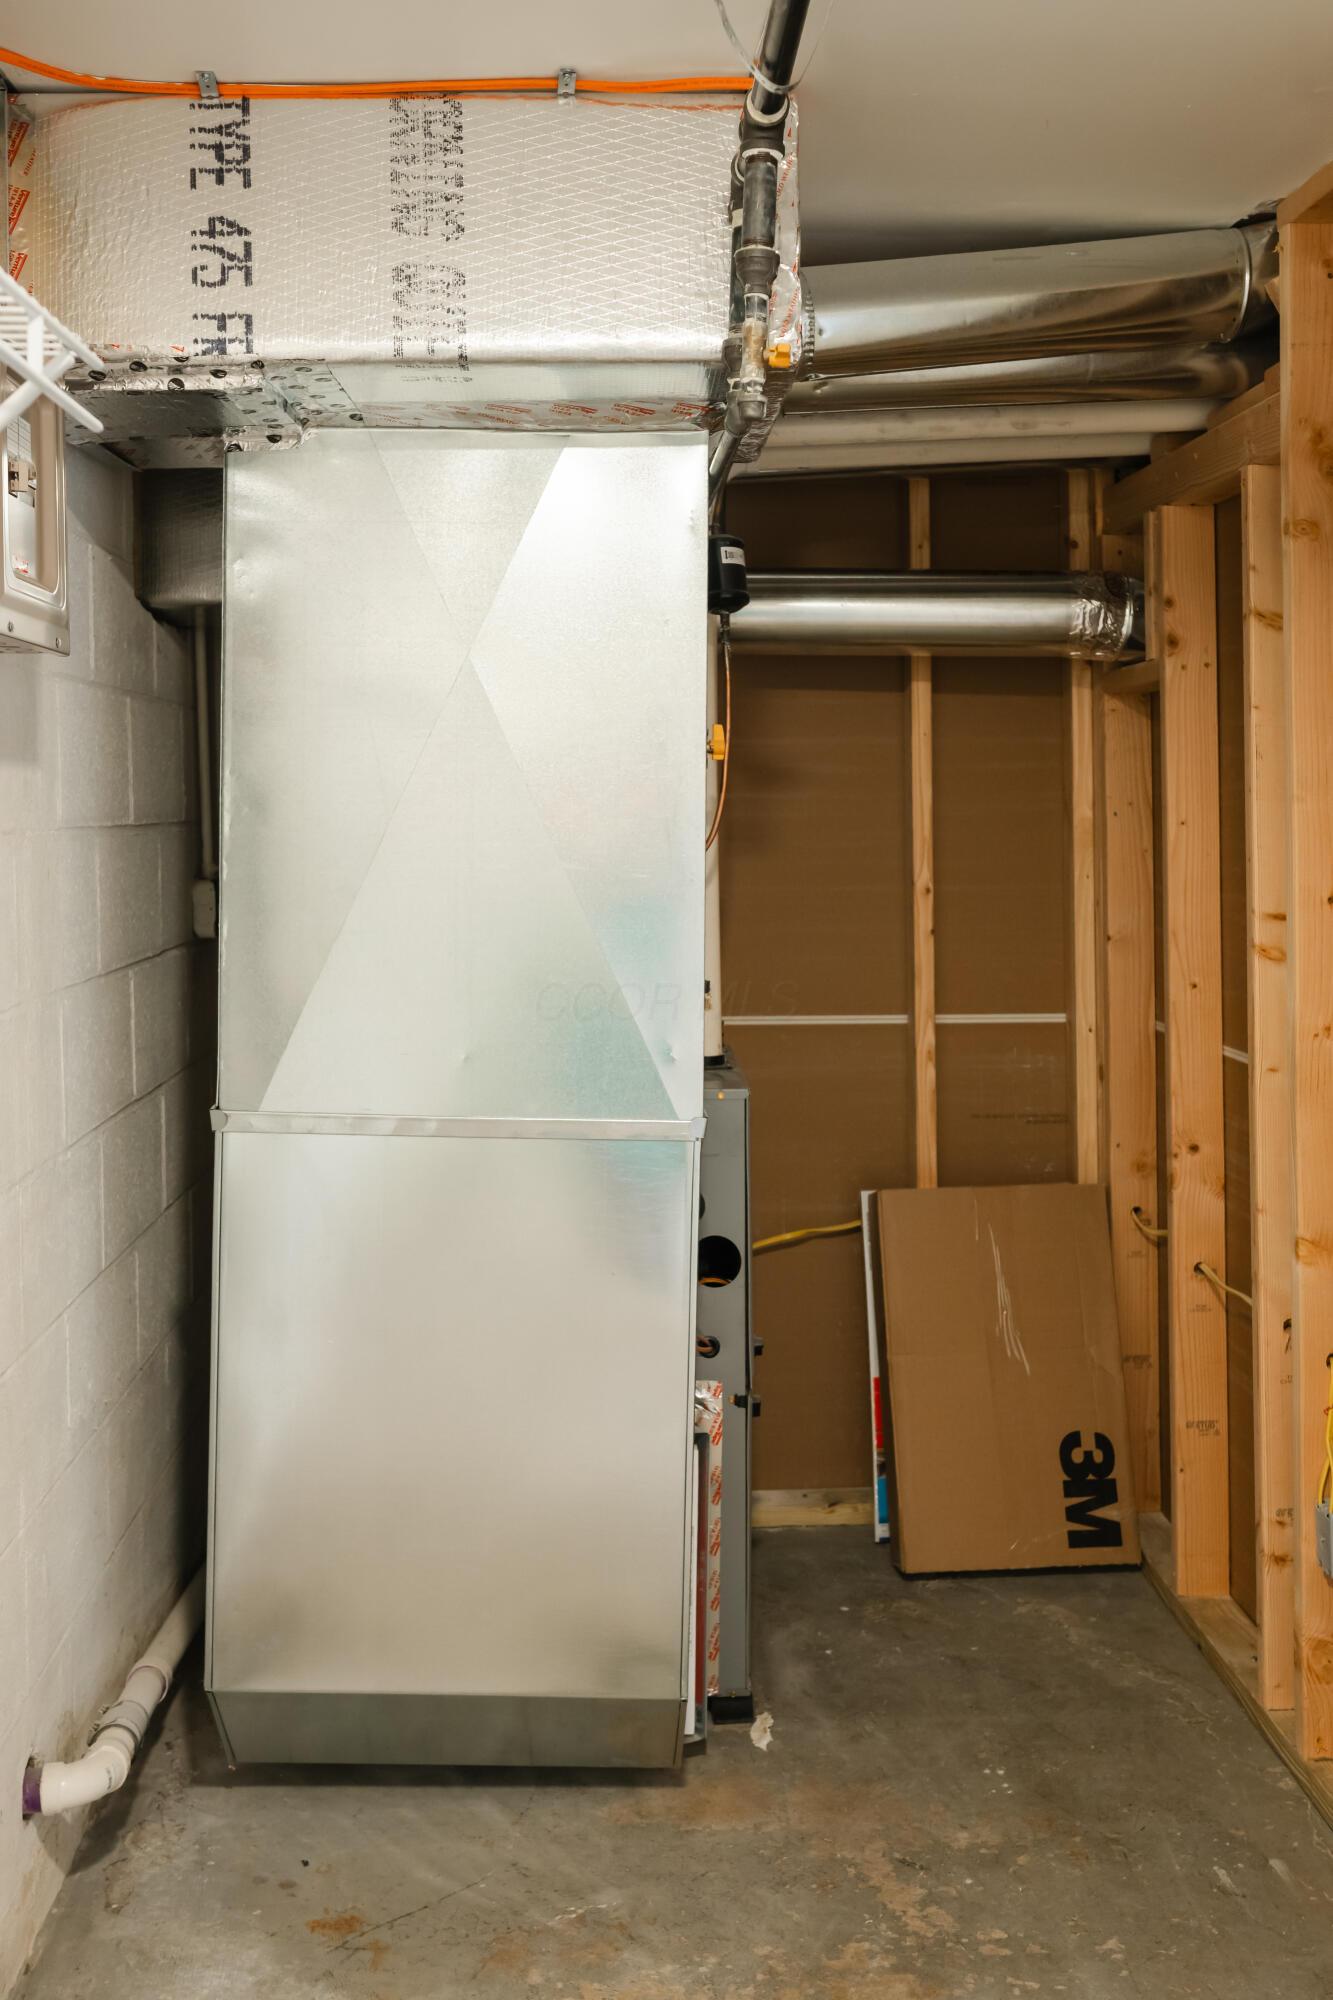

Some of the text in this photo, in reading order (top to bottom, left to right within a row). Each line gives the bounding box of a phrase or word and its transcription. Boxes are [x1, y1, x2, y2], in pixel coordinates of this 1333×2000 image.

[190, 96, 251, 190] TYPE
[191, 215, 253, 288] 475
[1059, 1430, 1123, 1549] 3M
